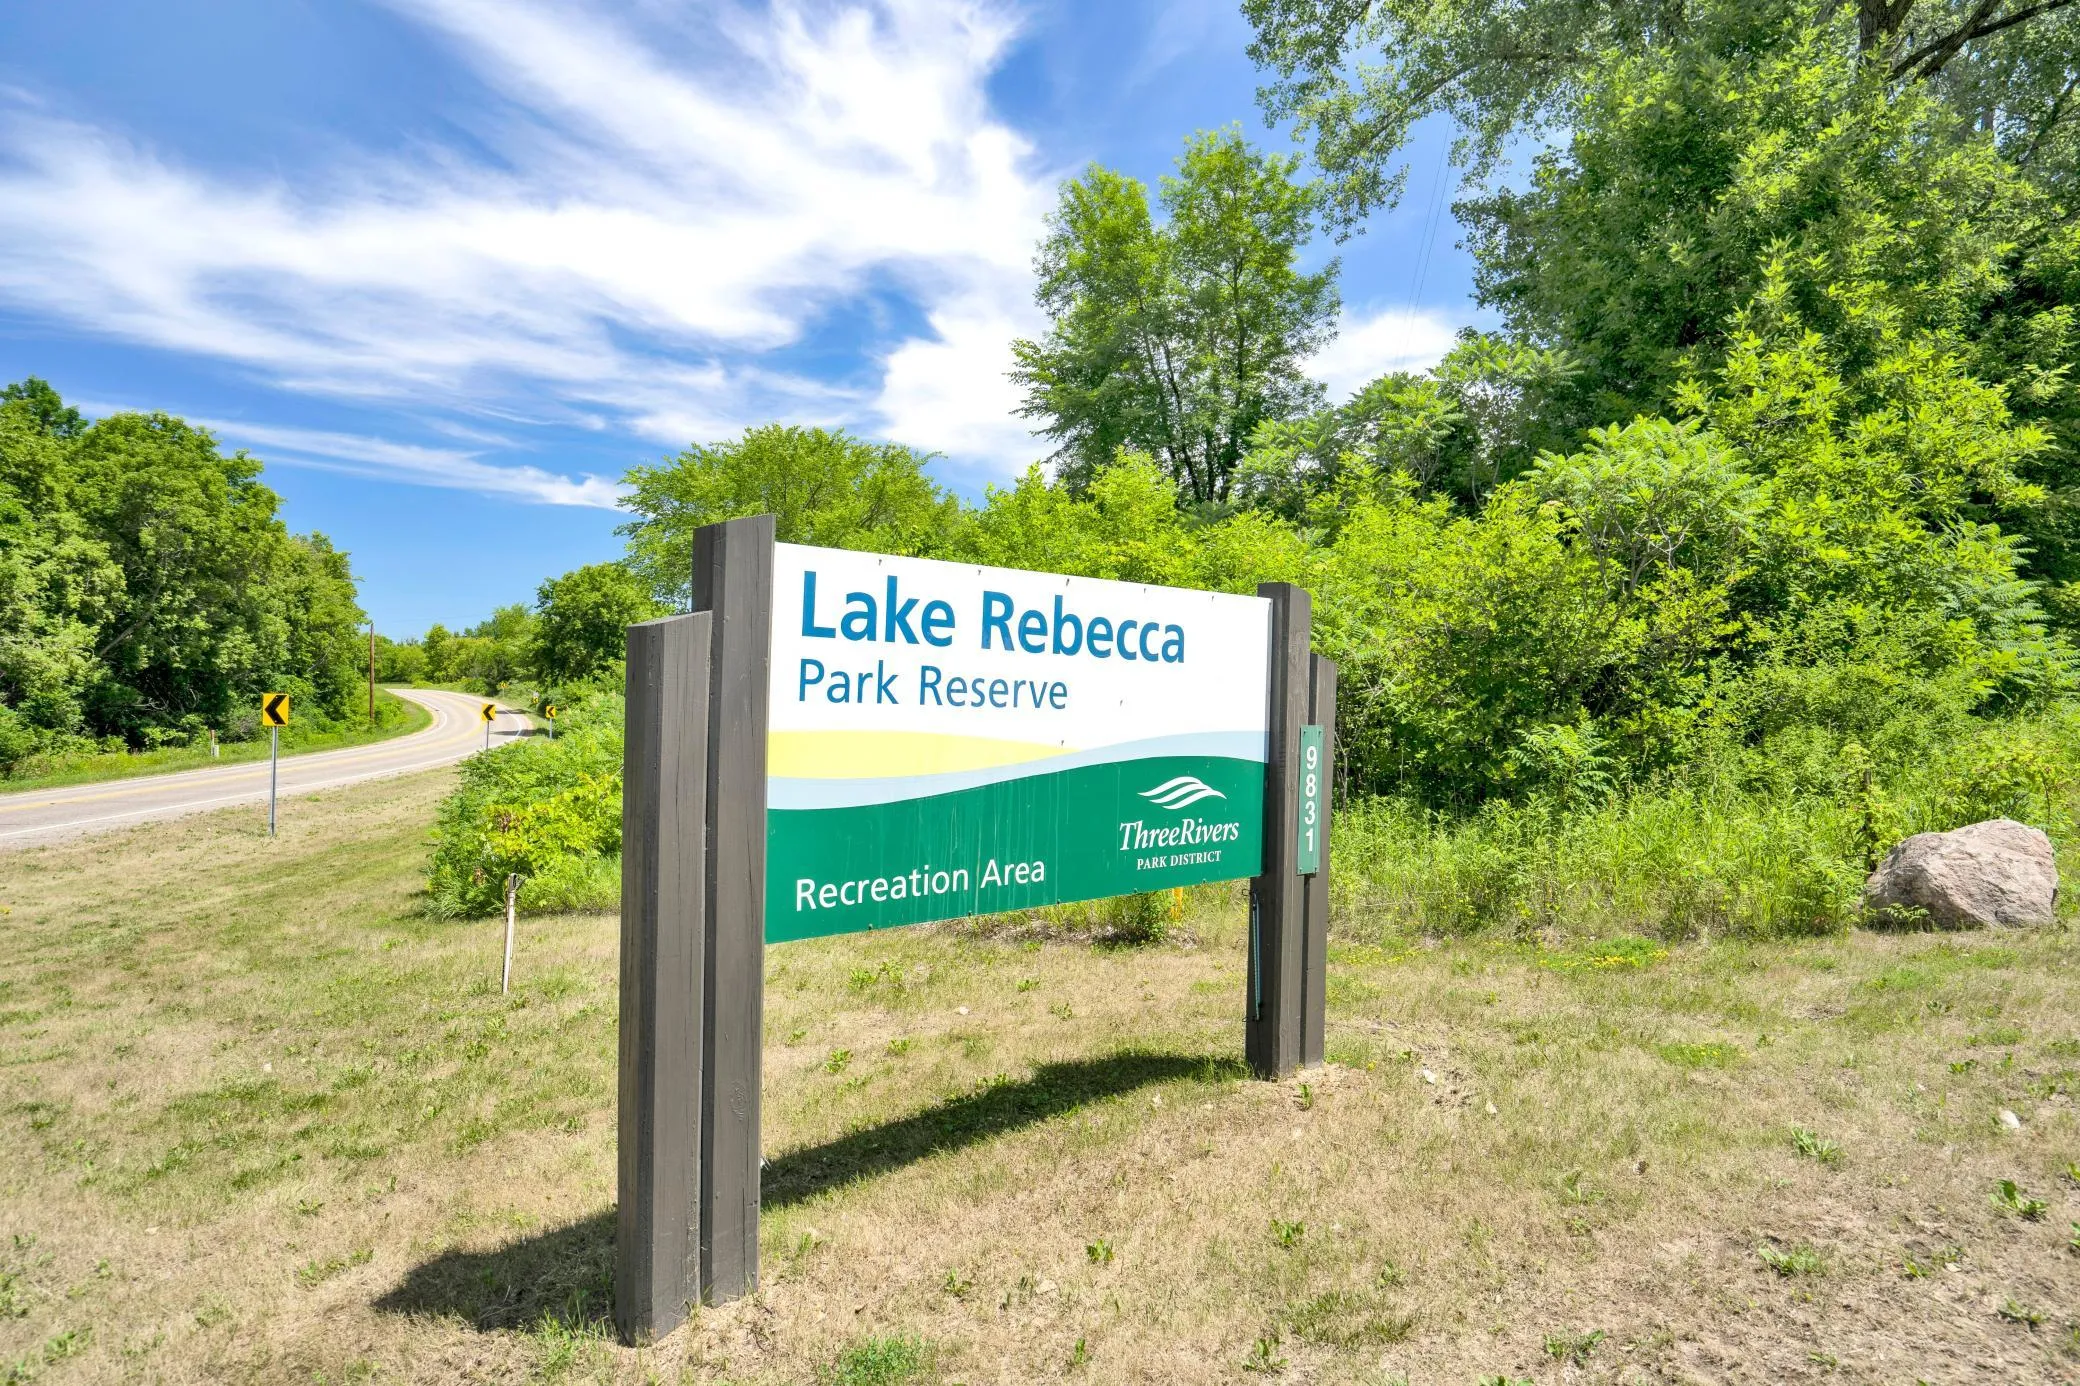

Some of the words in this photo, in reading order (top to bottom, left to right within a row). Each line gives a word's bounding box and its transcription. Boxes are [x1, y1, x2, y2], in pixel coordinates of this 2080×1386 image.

[801, 571, 956, 647] Lake
[981, 590, 1185, 663] Rebecca
[798, 659, 899, 705] Park
[919, 665, 1068, 709] Reserve
[1304, 745, 1318, 852] 9831
[1119, 818, 1239, 851] ThreeRivers
[1136, 855, 1167, 870] PARK
[1171, 850, 1222, 868] DISTRICT
[795, 865, 970, 911] Recreation
[980, 857, 1046, 888] Area
